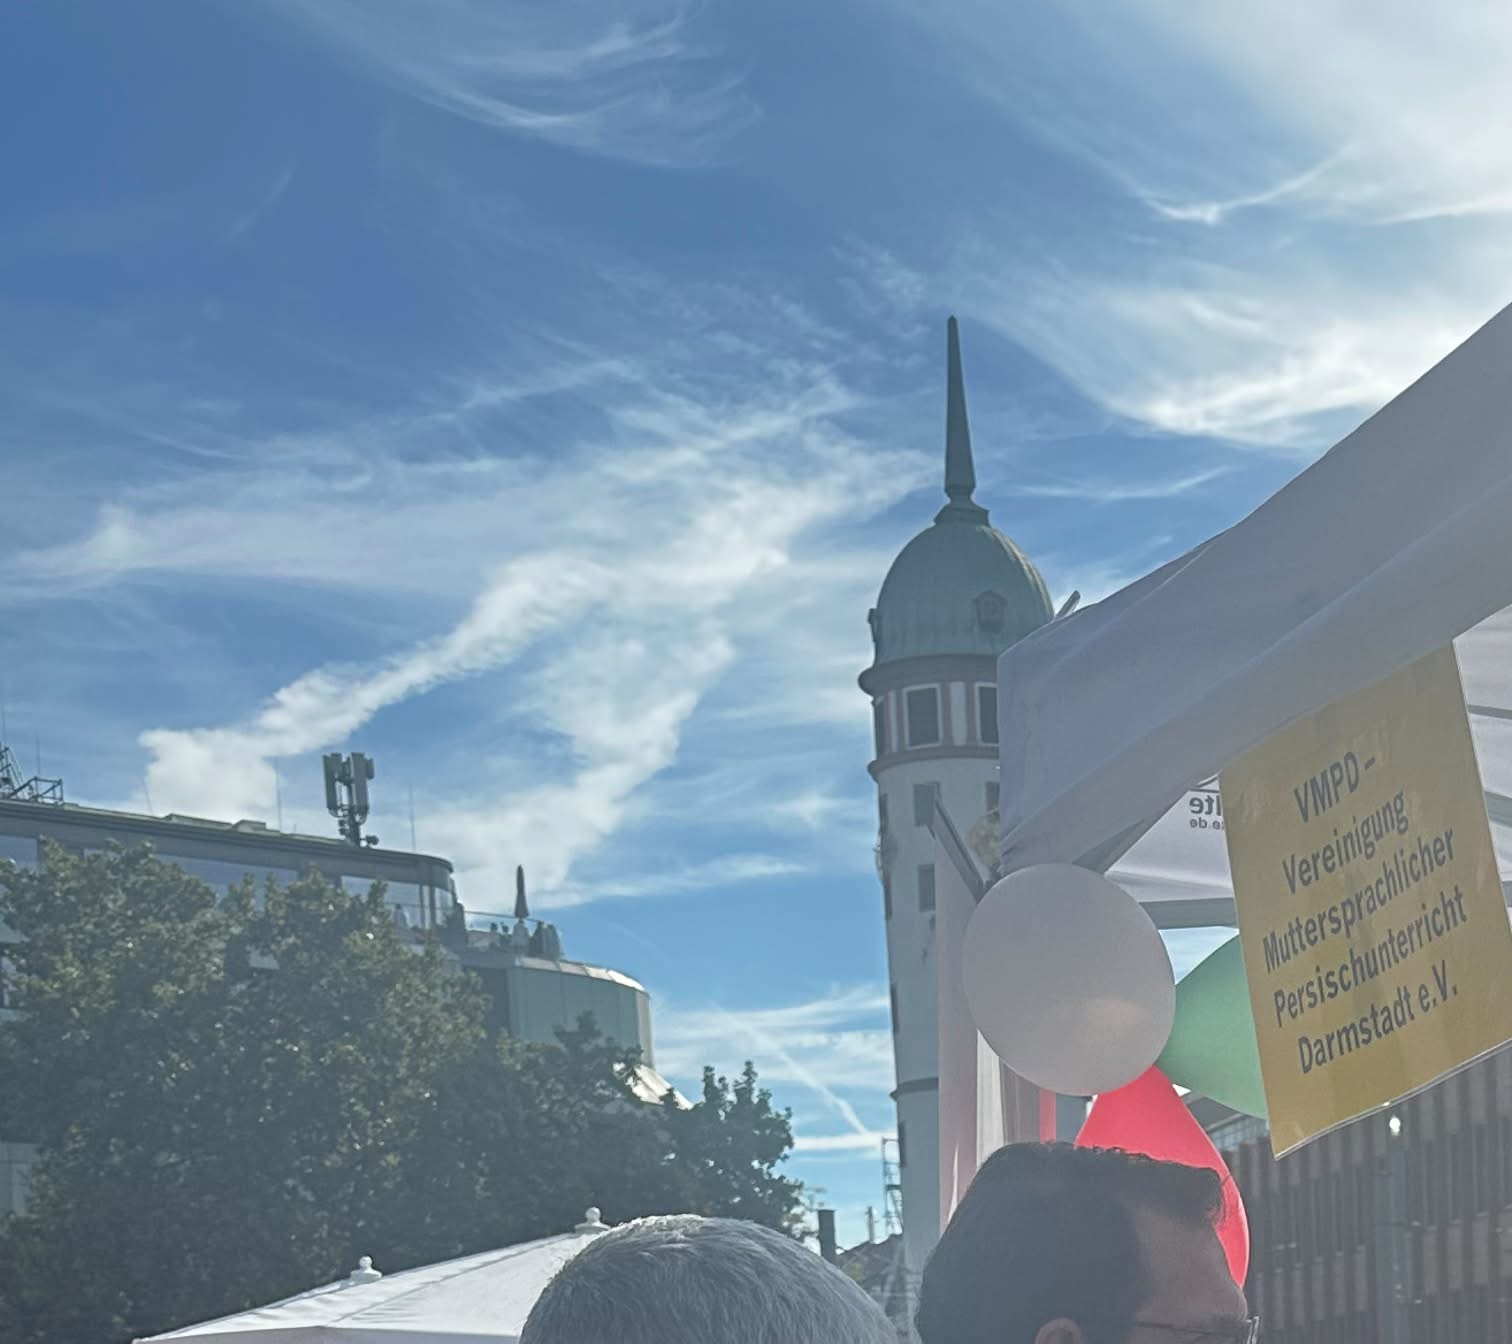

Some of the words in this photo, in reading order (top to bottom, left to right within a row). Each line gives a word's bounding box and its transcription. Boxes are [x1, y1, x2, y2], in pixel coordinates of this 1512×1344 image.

[1282, 791, 1409, 895] Vereinigung
[1294, 751, 1360, 823] VMPD
[1262, 828, 1454, 975] Muttersprachlicher
[1274, 885, 1467, 1028] Persischunterricht
[1298, 985, 1415, 1075] Darmstadt
[1418, 959, 1458, 1013] e.V.
